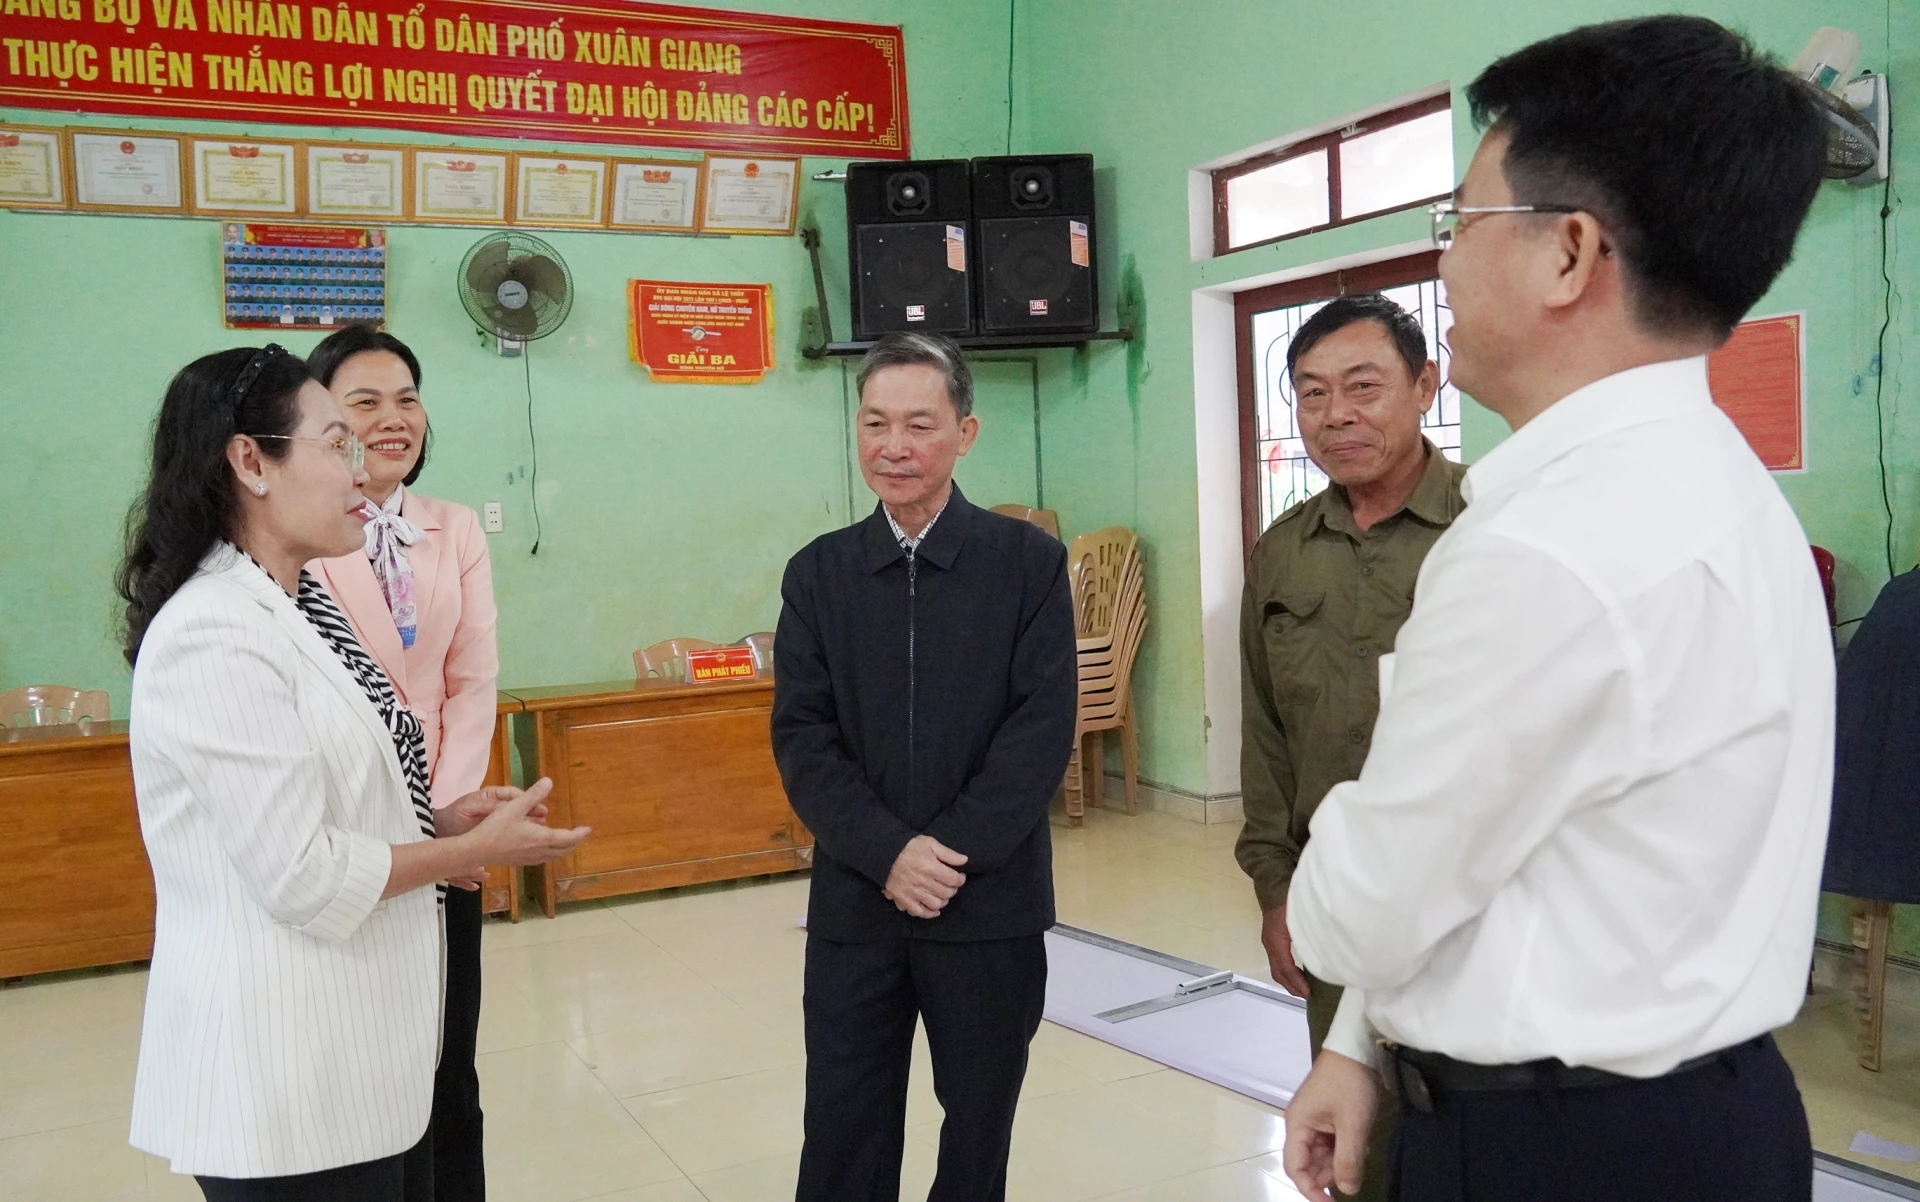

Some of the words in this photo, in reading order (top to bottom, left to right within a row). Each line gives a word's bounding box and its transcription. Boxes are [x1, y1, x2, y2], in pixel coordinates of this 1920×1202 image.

[206, 0, 303, 39] NHÂN
[311, 2, 379, 46] DÂN
[387, 3, 426, 50] TỔ
[434, 13, 498, 56] DÂN
[507, 17, 565, 62] PHỐ
[573, 27, 651, 68] XUÂN
[659, 38, 742, 75] GIANG
[3, 37, 99, 90] THỰC
[110, 42, 194, 94] HIỆN
[203, 45, 314, 97] THẮNG
[324, 63, 374, 107] LỢI
[382, 68, 458, 114] NGHỊ
[467, 69, 558, 113] QUYẾT
[566, 81, 614, 123] ĐẠI
[622, 80, 669, 126] HỘI
[676, 81, 750, 125] ĐẢNG
[757, 90, 809, 128] CÁC
[816, 94, 875, 133] CẤP!
[908, 306, 924, 316] JBL
[1032, 300, 1047, 311] JBL
[668, 351, 705, 365] GIẢI
[710, 354, 737, 365] BA
[696, 667, 711, 678] BÀN
[711, 665, 729, 676] PHÁT
[730, 663, 750, 675] PHIẾU
